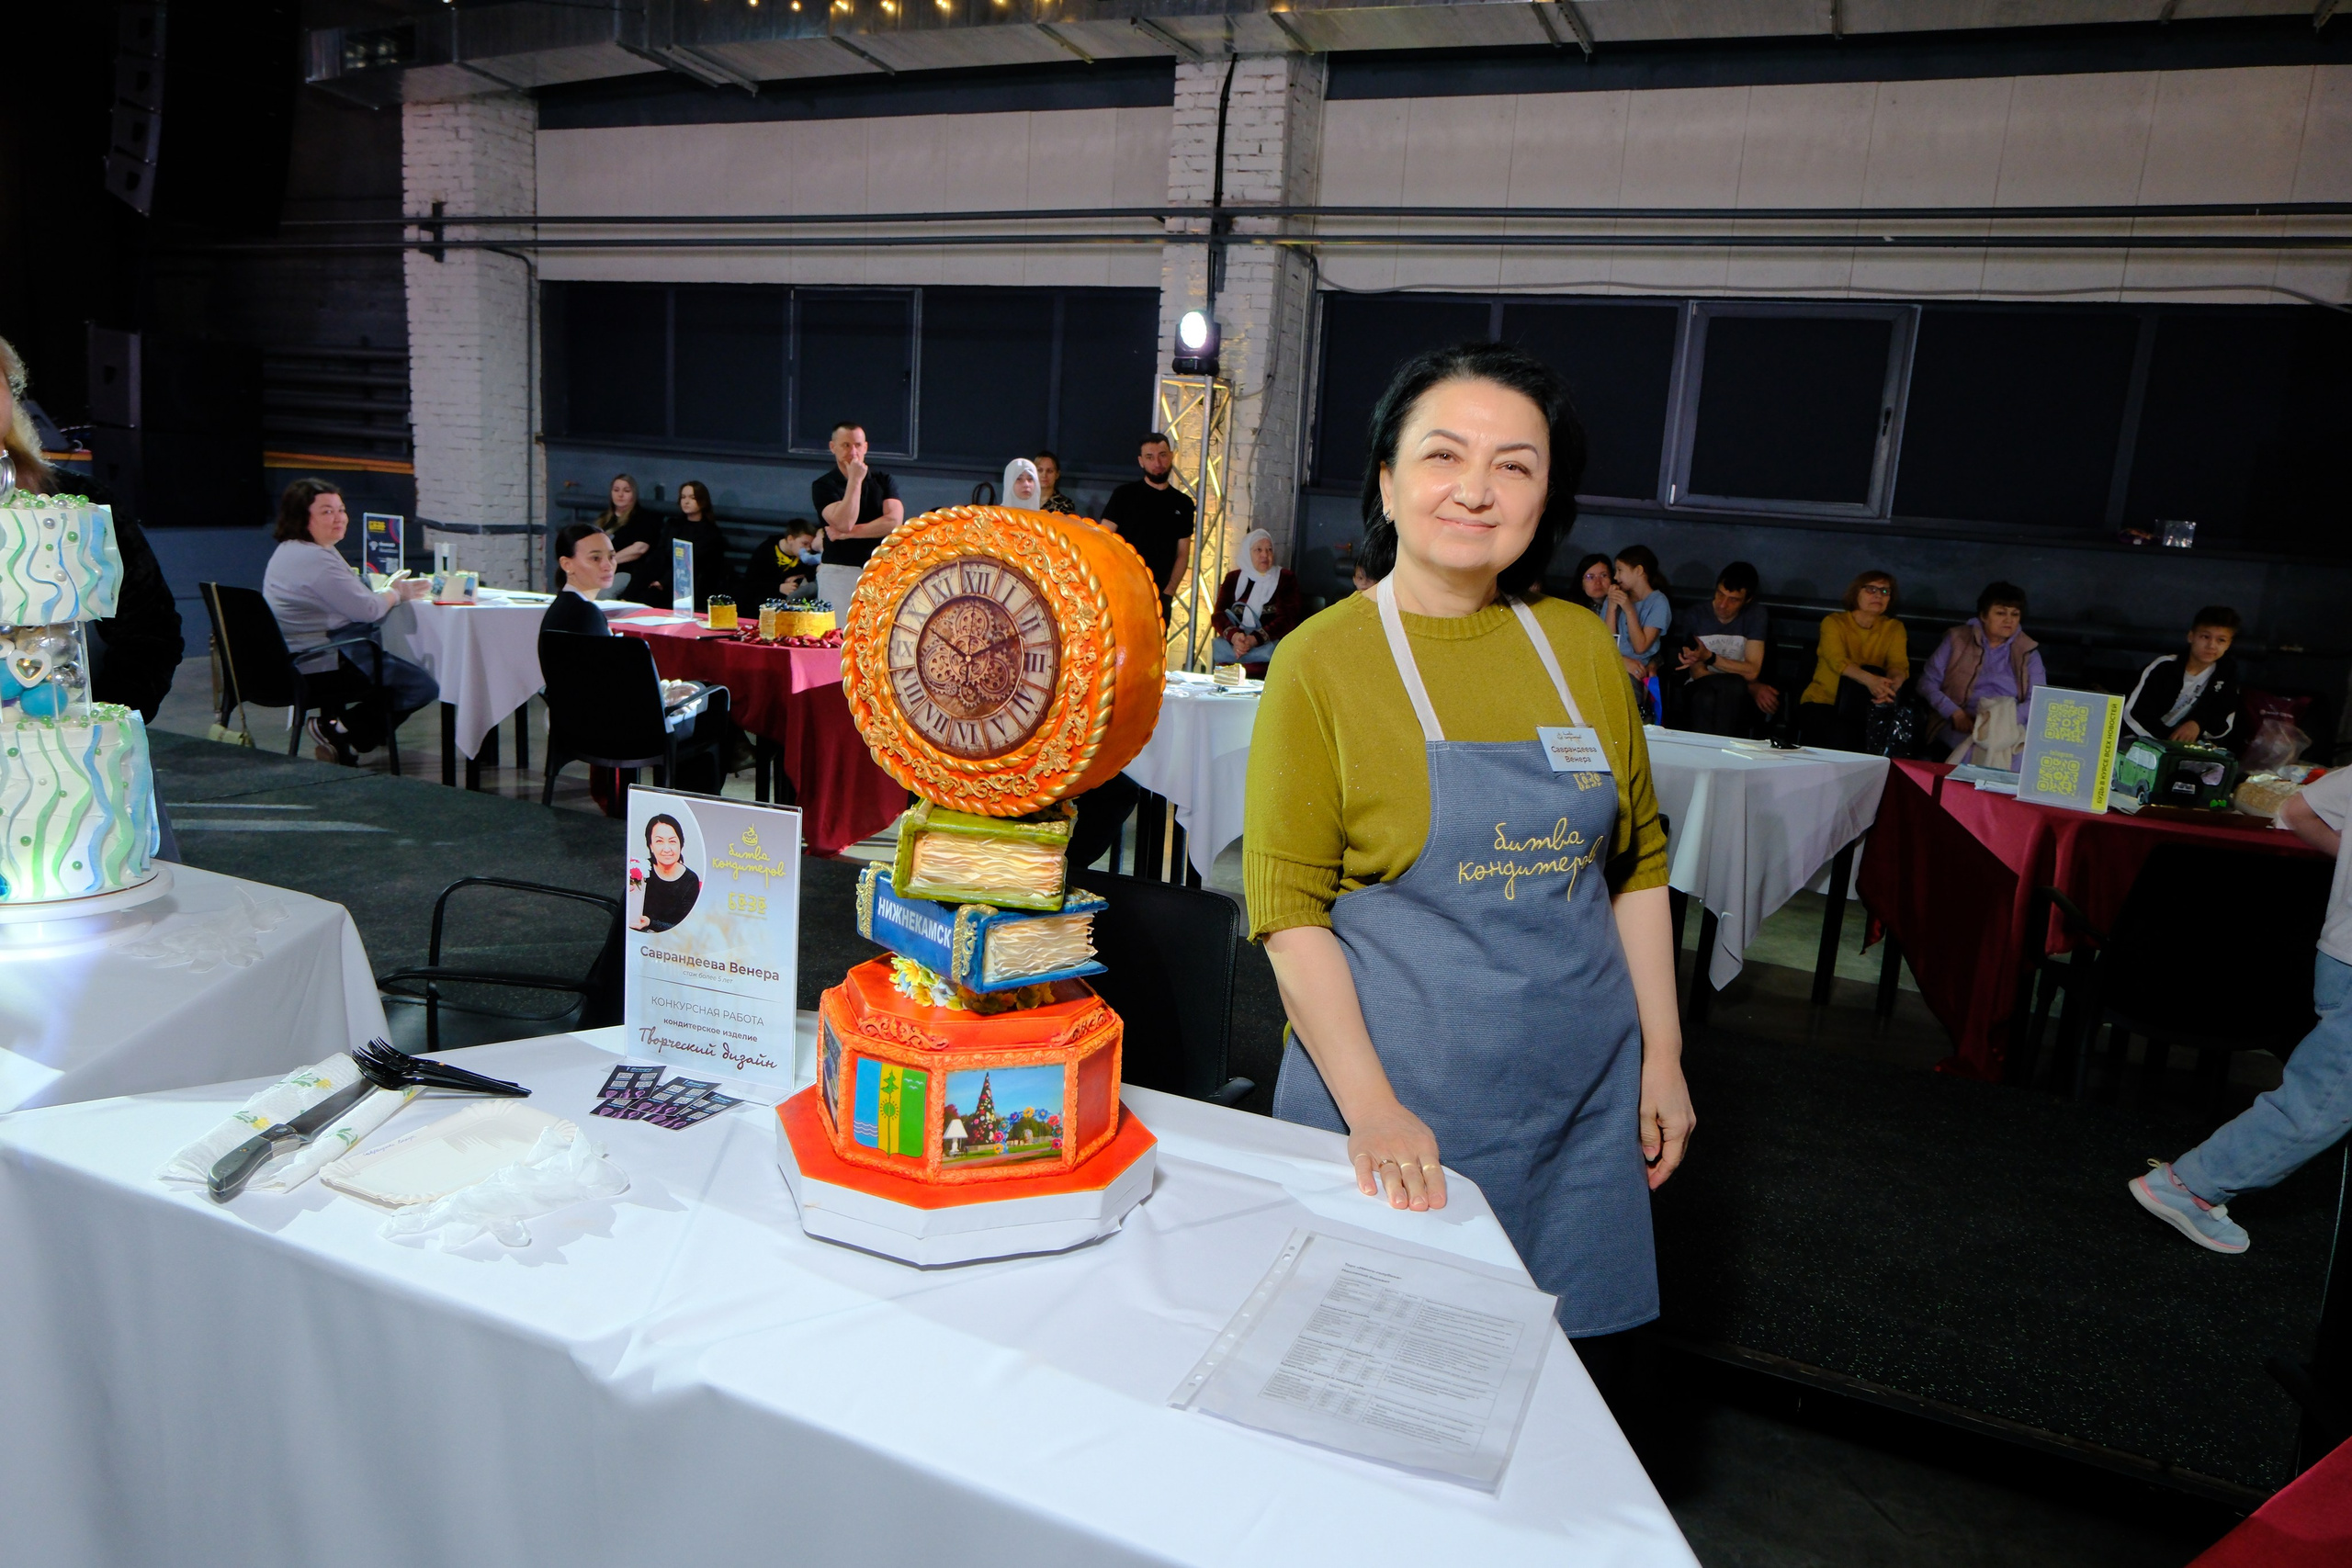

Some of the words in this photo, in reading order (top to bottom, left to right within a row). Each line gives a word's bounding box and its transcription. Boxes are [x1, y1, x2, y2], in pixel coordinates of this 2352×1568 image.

[963, 570, 990, 594] XII
[896, 640, 913, 658] IX
[1024, 652, 1045, 672] III
[900, 668, 925, 705] VIII
[926, 703, 949, 734] VII
[990, 715, 1007, 738] V
[2107, 704, 2119, 739] НОВОСТЕЙ
[956, 722, 976, 744] VI
[2104, 740, 2112, 758] ВСЕХ
[2100, 761, 2109, 778] КУРСЕ
[2097, 784, 2106, 804] БУДЬ
[1494, 817, 1585, 852] битва
[729, 842, 770, 861] битва
[712, 857, 786, 889] кондитеров
[877, 897, 953, 948] НИЖНЕКАМСК
[639, 945, 726, 972] Саврандеева
[729, 962, 780, 982] Венера
[698, 972, 718, 982] более
[651, 996, 720, 1018] КОНКУРСНАЯ
[723, 1010, 764, 1026] РАБОТА
[663, 1019, 720, 1035] кондитерское
[722, 1030, 758, 1043] изделие
[639, 1026, 717, 1054] Творческий
[722, 1042, 778, 1070] дизайн
